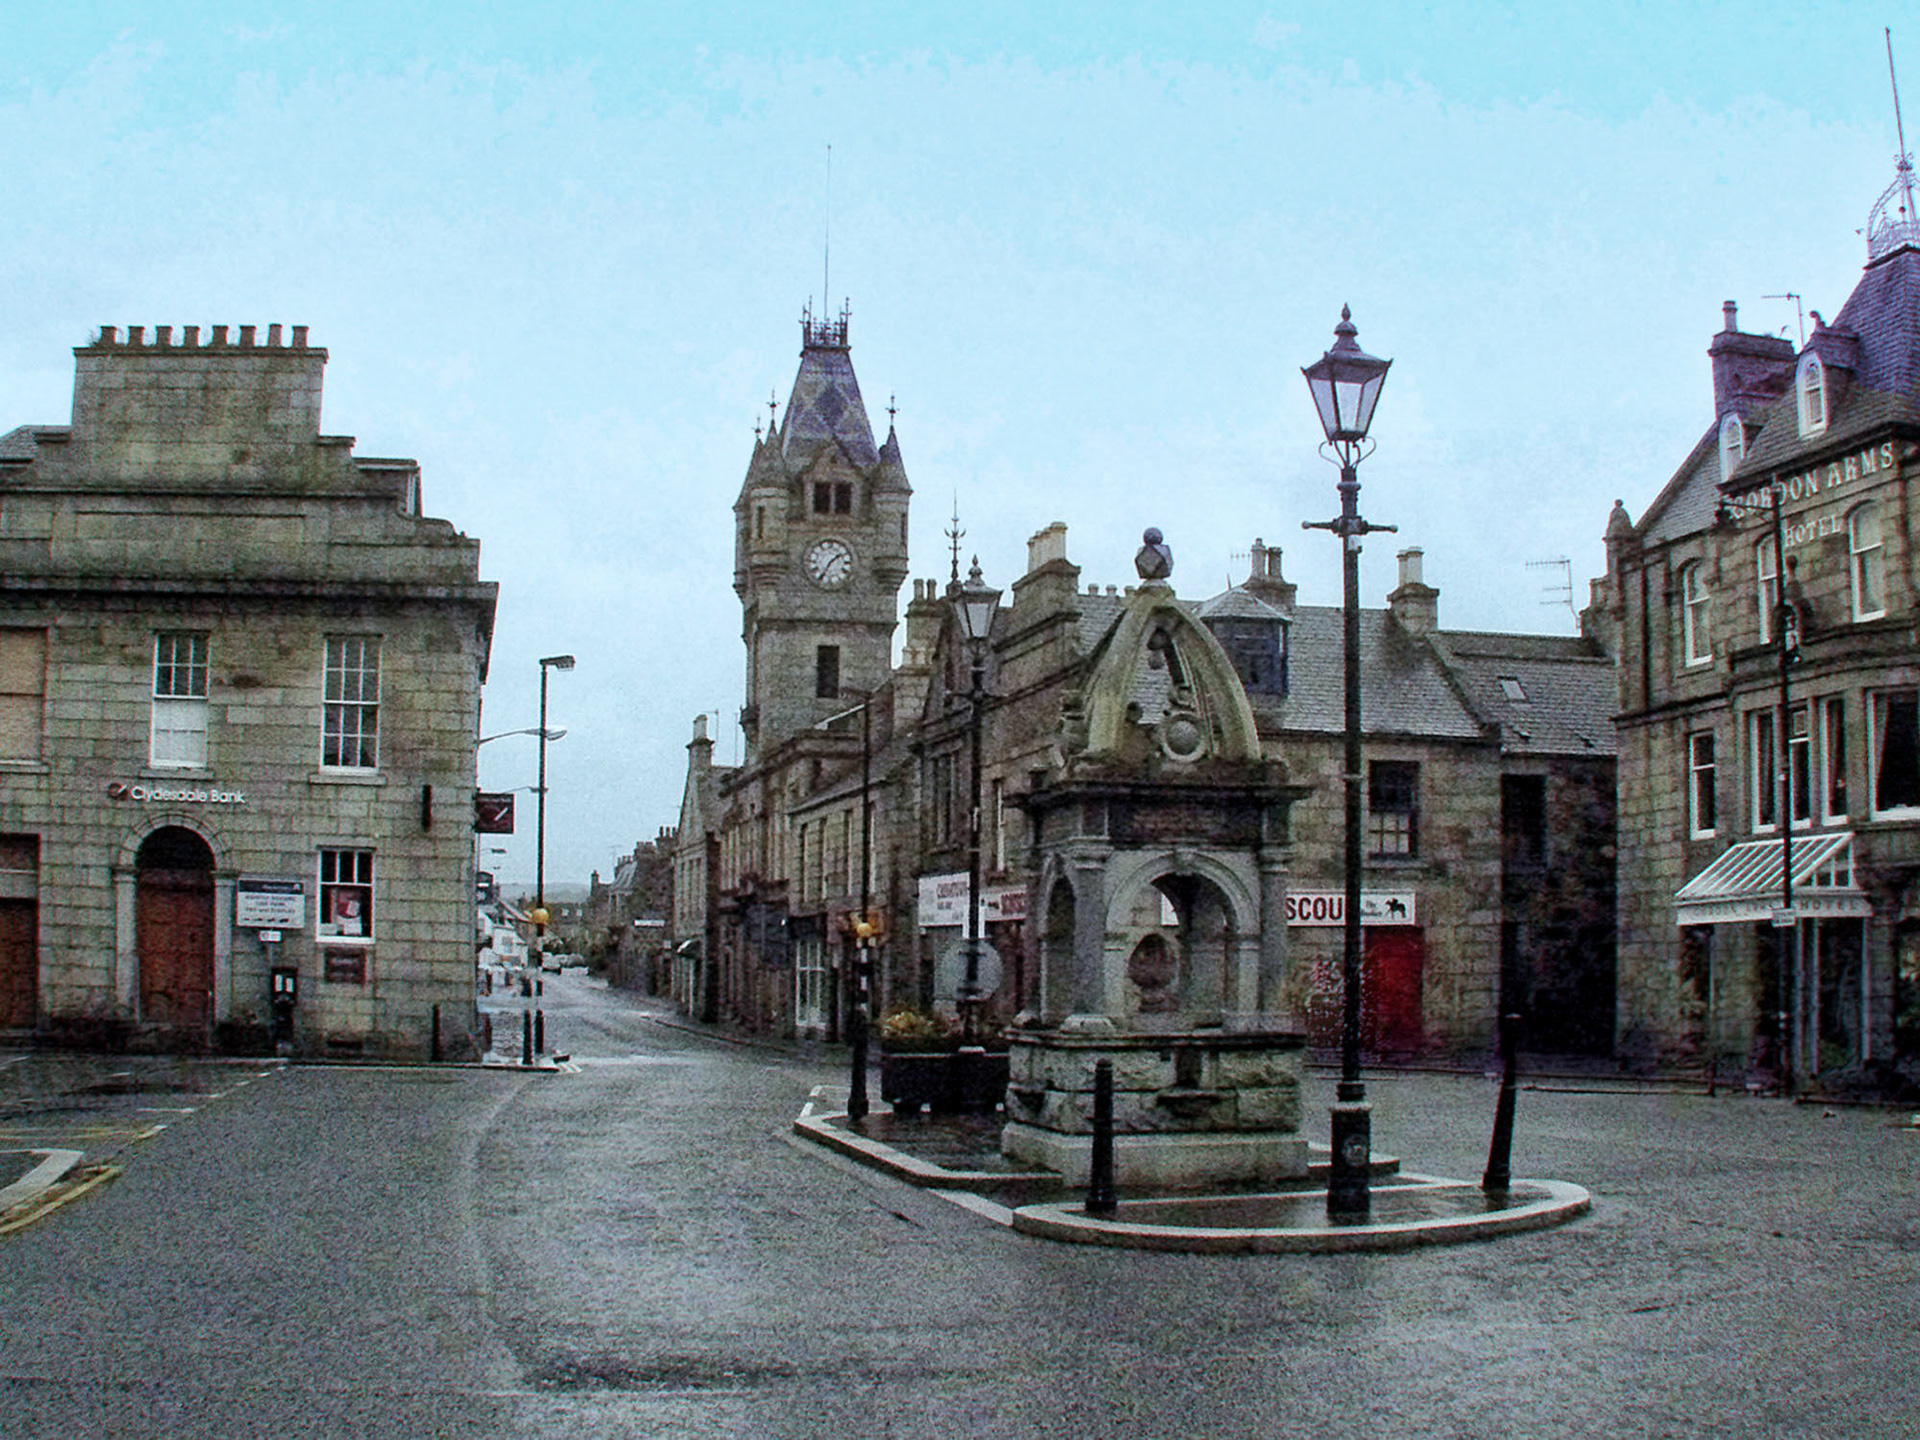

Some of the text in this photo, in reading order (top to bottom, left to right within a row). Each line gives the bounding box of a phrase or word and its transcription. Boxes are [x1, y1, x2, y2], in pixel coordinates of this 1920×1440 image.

[1827, 442, 1895, 488] ARMS
[1783, 514, 1842, 547] HOTEL
[131, 786, 246, 804] Clydesdale Bank
